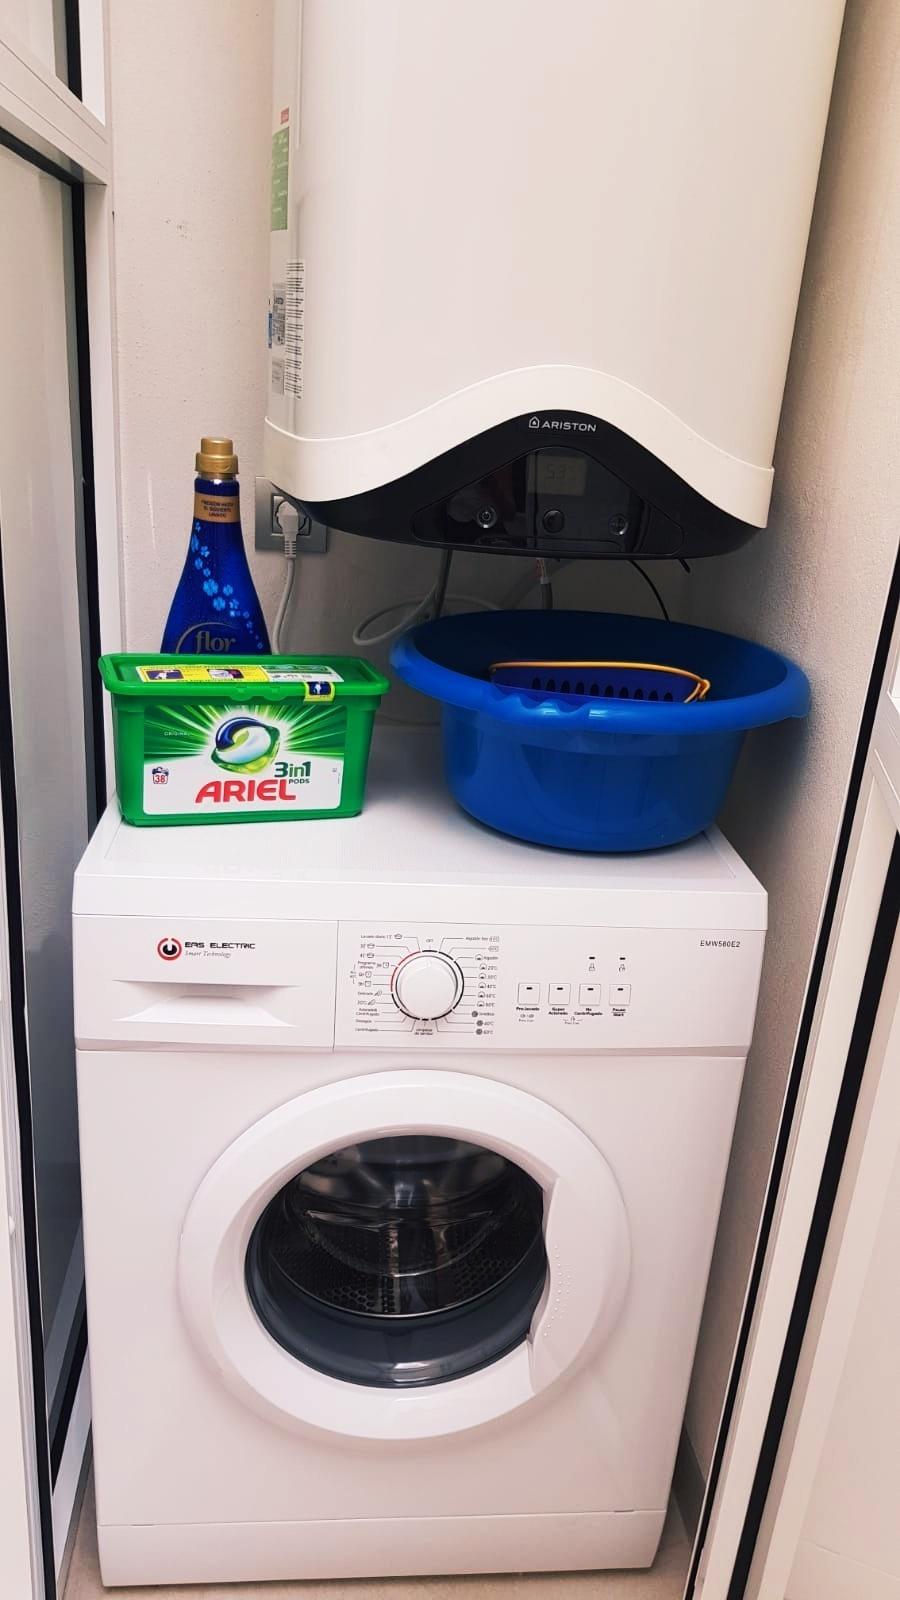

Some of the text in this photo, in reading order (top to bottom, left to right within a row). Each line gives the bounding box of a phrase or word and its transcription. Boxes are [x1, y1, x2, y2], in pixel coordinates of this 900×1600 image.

[541, 420, 597, 432] ARISTON
[196, 630, 236, 653] flor
[274, 761, 312, 778] 3in1
[155, 774, 166, 783] 38
[195, 779, 297, 803] ARIEL
[184, 941, 256, 950] EAS ELECTRIC
[700, 940, 741, 948] EMW580E2
[203, 951, 231, 959] Technology
